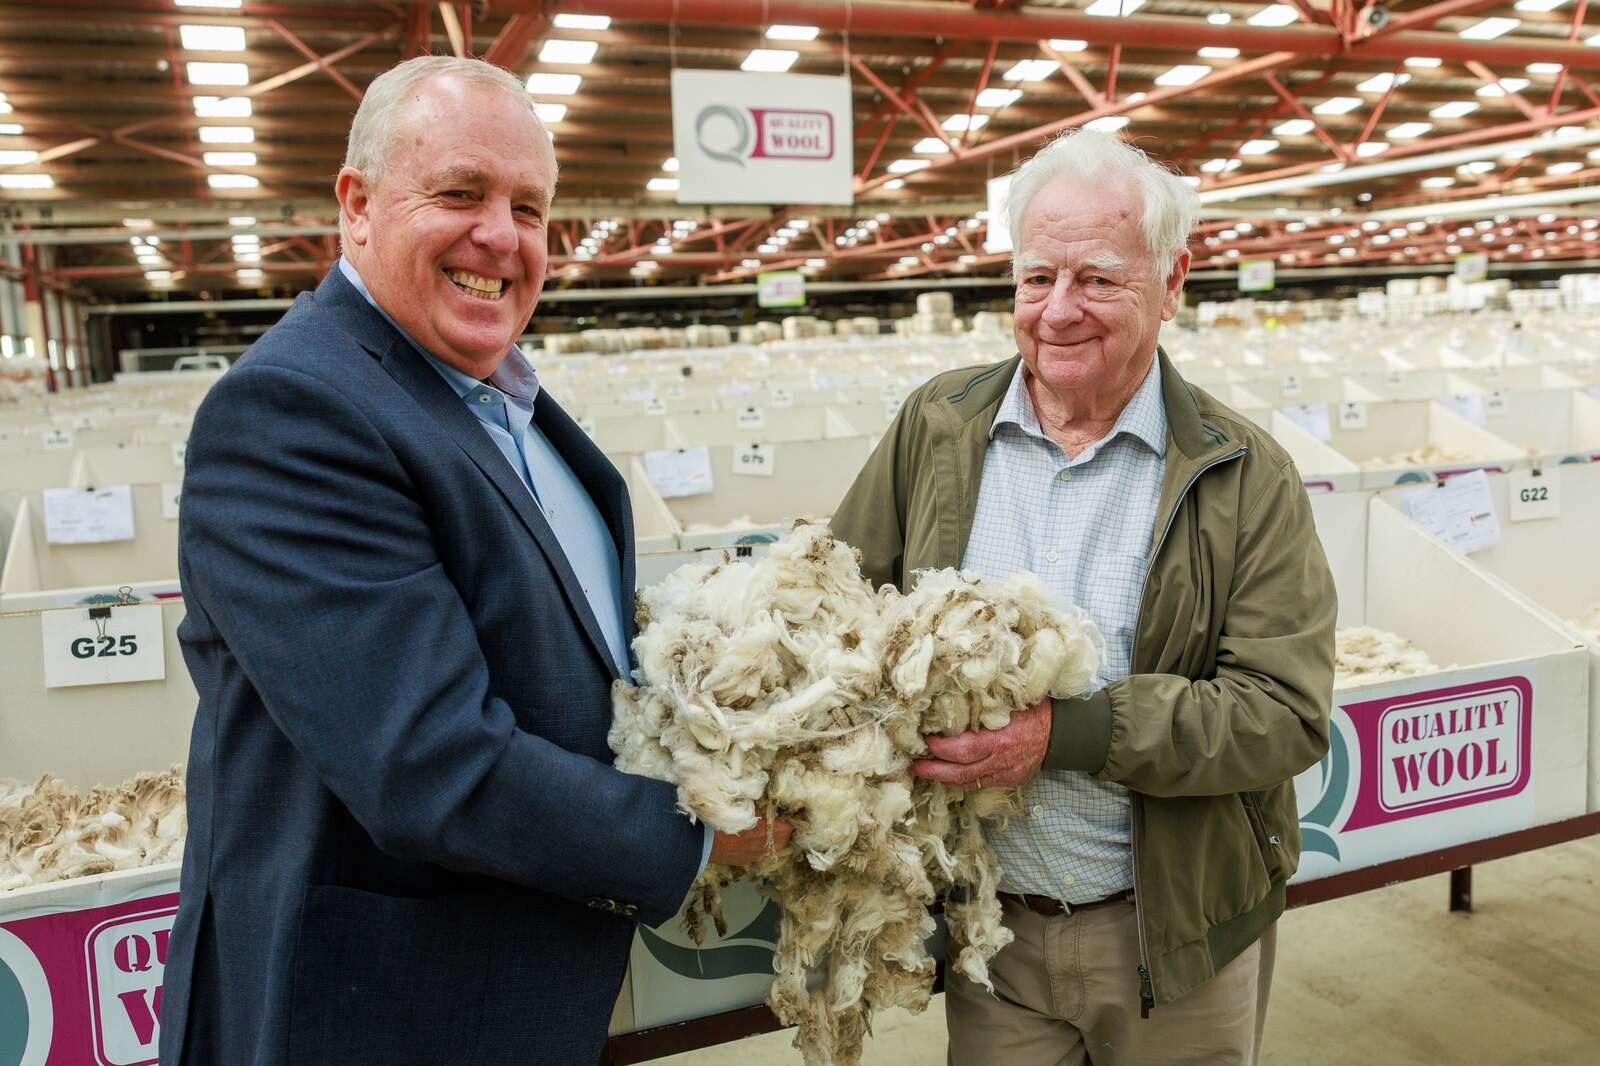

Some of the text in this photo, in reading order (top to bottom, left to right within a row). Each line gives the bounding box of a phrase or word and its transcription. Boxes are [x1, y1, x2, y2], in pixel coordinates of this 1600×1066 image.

[769, 119, 822, 130] QUALITY
[771, 134, 822, 150] WOOL
[1520, 486, 1549, 503] G22
[71, 634, 138, 659] G25
[1391, 700, 1509, 744] QUALITY
[1391, 738, 1508, 794] WOOL
